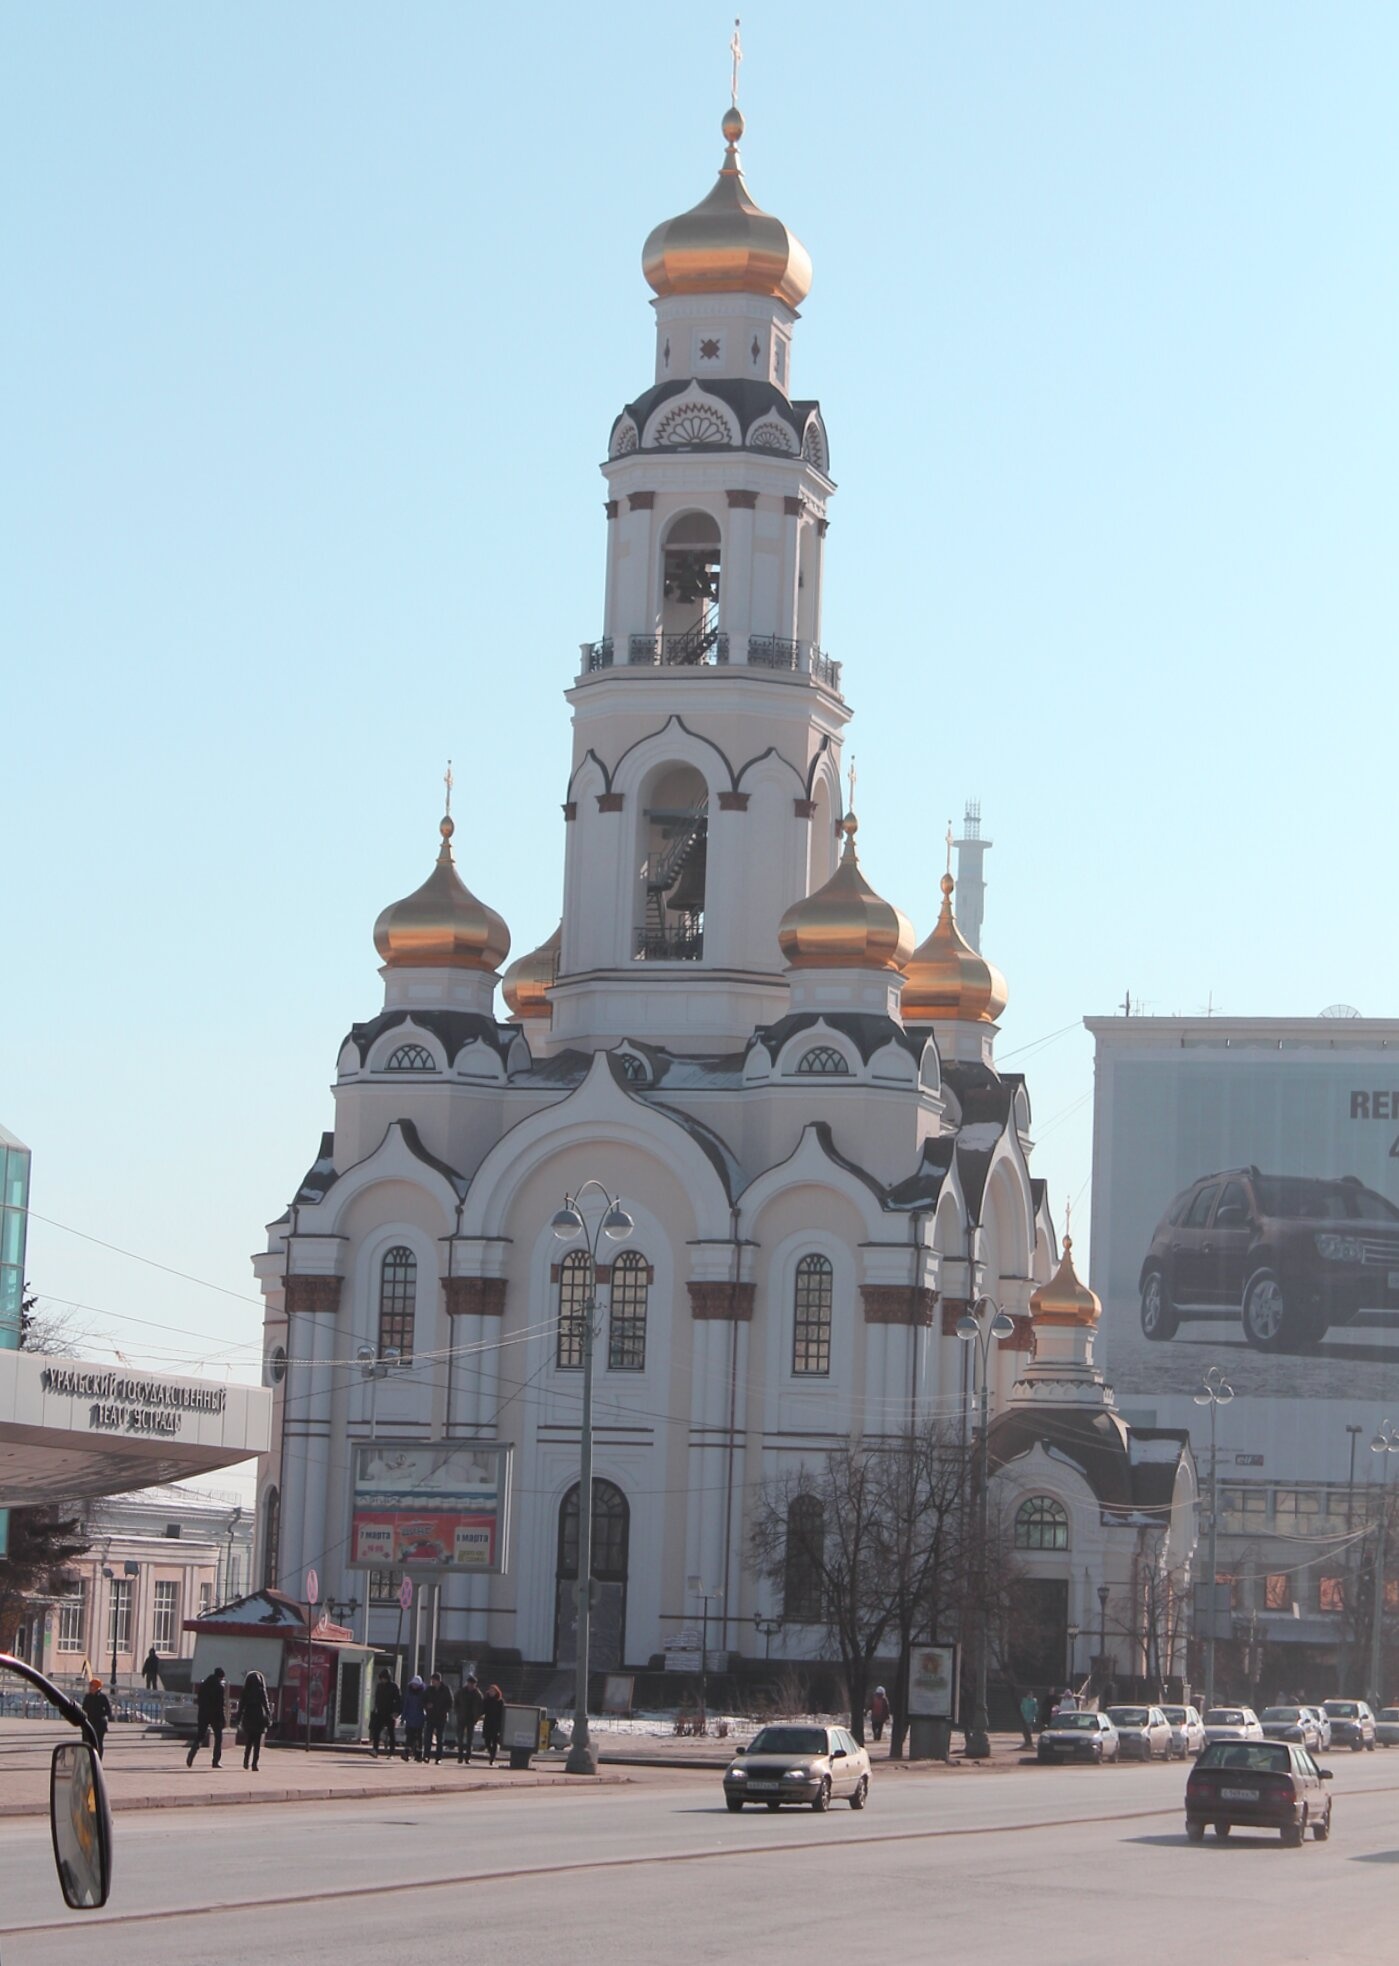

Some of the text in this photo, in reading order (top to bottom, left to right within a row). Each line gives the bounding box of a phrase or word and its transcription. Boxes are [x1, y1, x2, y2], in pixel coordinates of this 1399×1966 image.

[50, 1369, 227, 1411] УРАЛЬСКИЙ ГОСУДАРСТВЕННЫЙ
[98, 1403, 182, 1432] ТЕАТР ЭСТРАДЫ
